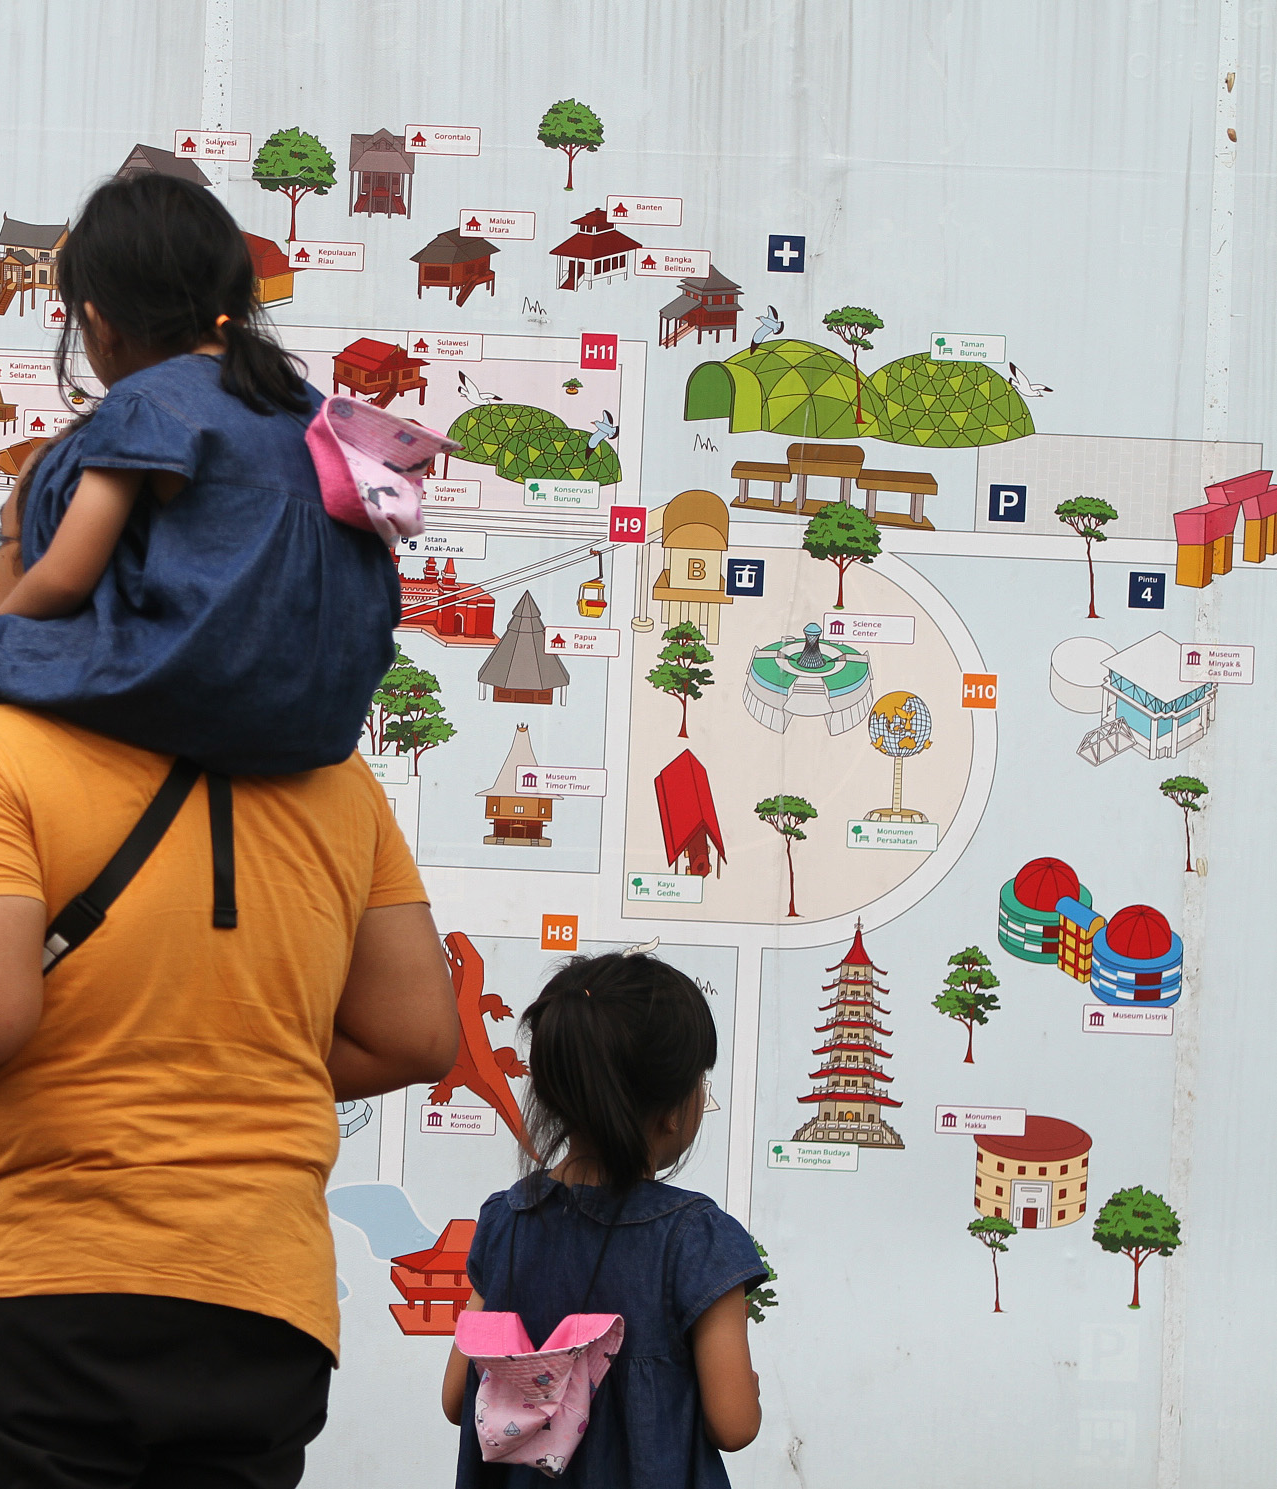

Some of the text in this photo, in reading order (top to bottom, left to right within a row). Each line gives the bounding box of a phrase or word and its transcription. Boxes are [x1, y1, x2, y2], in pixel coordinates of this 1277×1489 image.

[205, 138, 237, 146] Sulawesi
[318, 249, 356, 257] Kepulauan
[664, 256, 692, 264] Bangka
[665, 263, 695, 273] Belitung
[437, 348, 463, 356] Tengah
[586, 345, 614, 359] H11
[960, 350, 986, 358] Burung
[999, 491, 1018, 515] P
[616, 518, 641, 532] H9
[686, 557, 707, 581] B
[1142, 588, 1152, 601] 4
[964, 685, 996, 699] H10
[657, 881, 675, 889] Kayu
[548, 927, 572, 940] H8
[824, 1149, 850, 1157] Budaya
[797, 1157, 830, 1165] Tionghoa
